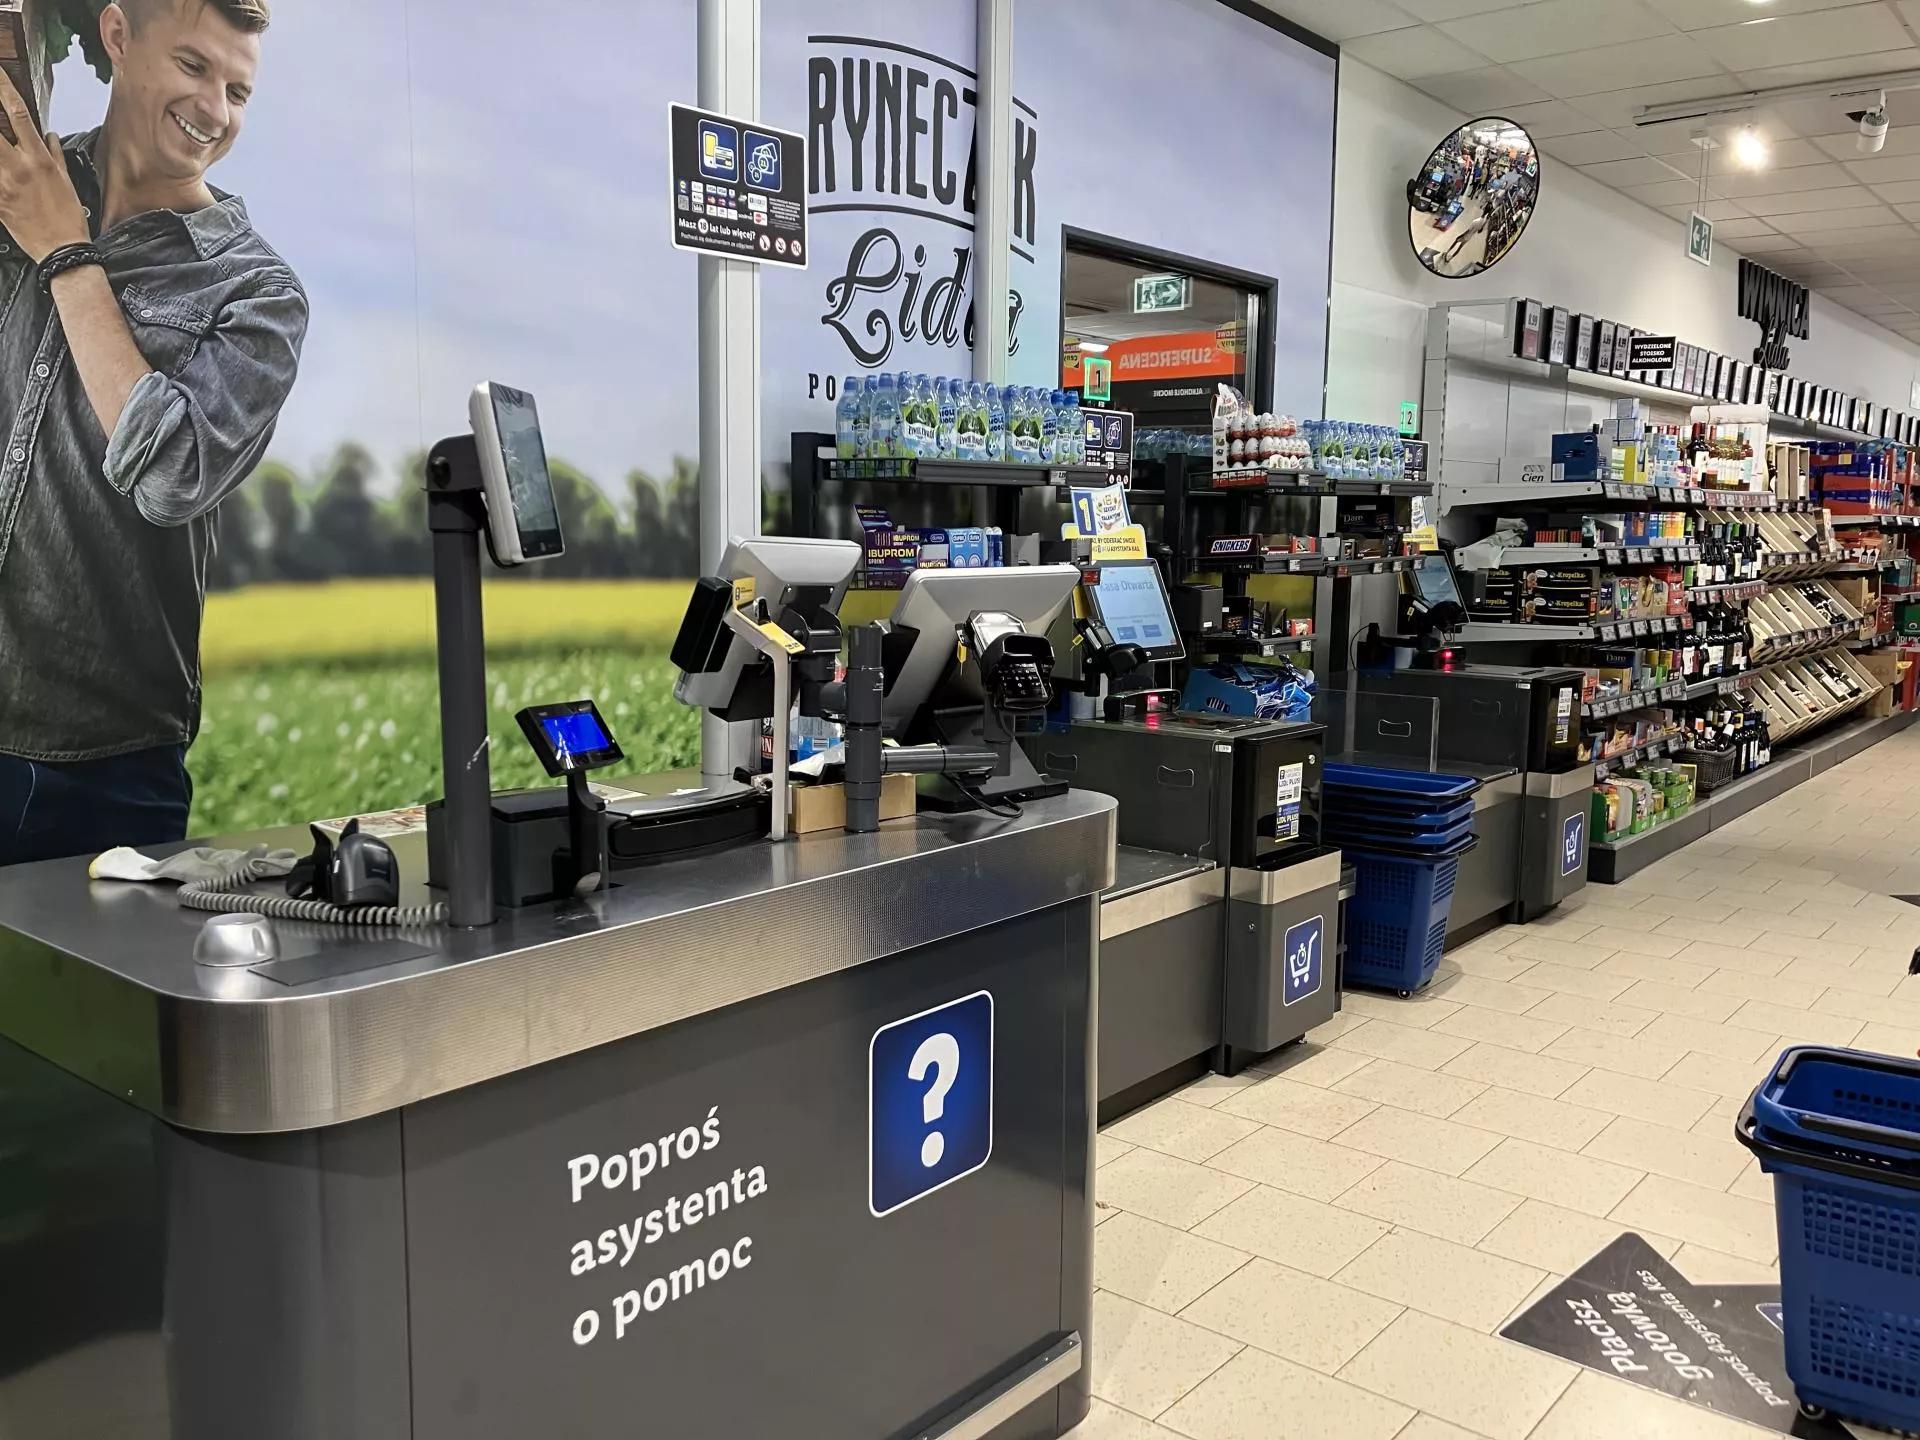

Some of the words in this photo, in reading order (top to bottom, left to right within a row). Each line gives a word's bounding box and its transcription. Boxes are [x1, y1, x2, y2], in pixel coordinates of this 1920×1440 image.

[808, 56, 1036, 246] RYNECZK
[678, 218, 696, 229] Masz
[710, 223, 718, 233] lat
[720, 225, 731, 236] lub
[732, 228, 756, 240] więcej?
[1738, 259, 1809, 340] WINNICA
[1096, 370, 1101, 389] 1
[1407, 410, 1413, 425] 2
[1522, 473, 1544, 482] Cien
[893, 534, 920, 542] IBUPROM
[1213, 540, 1250, 550] SNICKERS
[868, 548, 914, 558] IBUPROM
[1120, 580, 1154, 590] Otwarta
[568, 1105, 721, 1203] Poproś
[570, 1164, 768, 1276] asystenta
[572, 1309, 600, 1346] o
[612, 1236, 753, 1339] pomoc
[1566, 1299, 1649, 1373] Płacisz
[1607, 1291, 1714, 1380] gotówką
